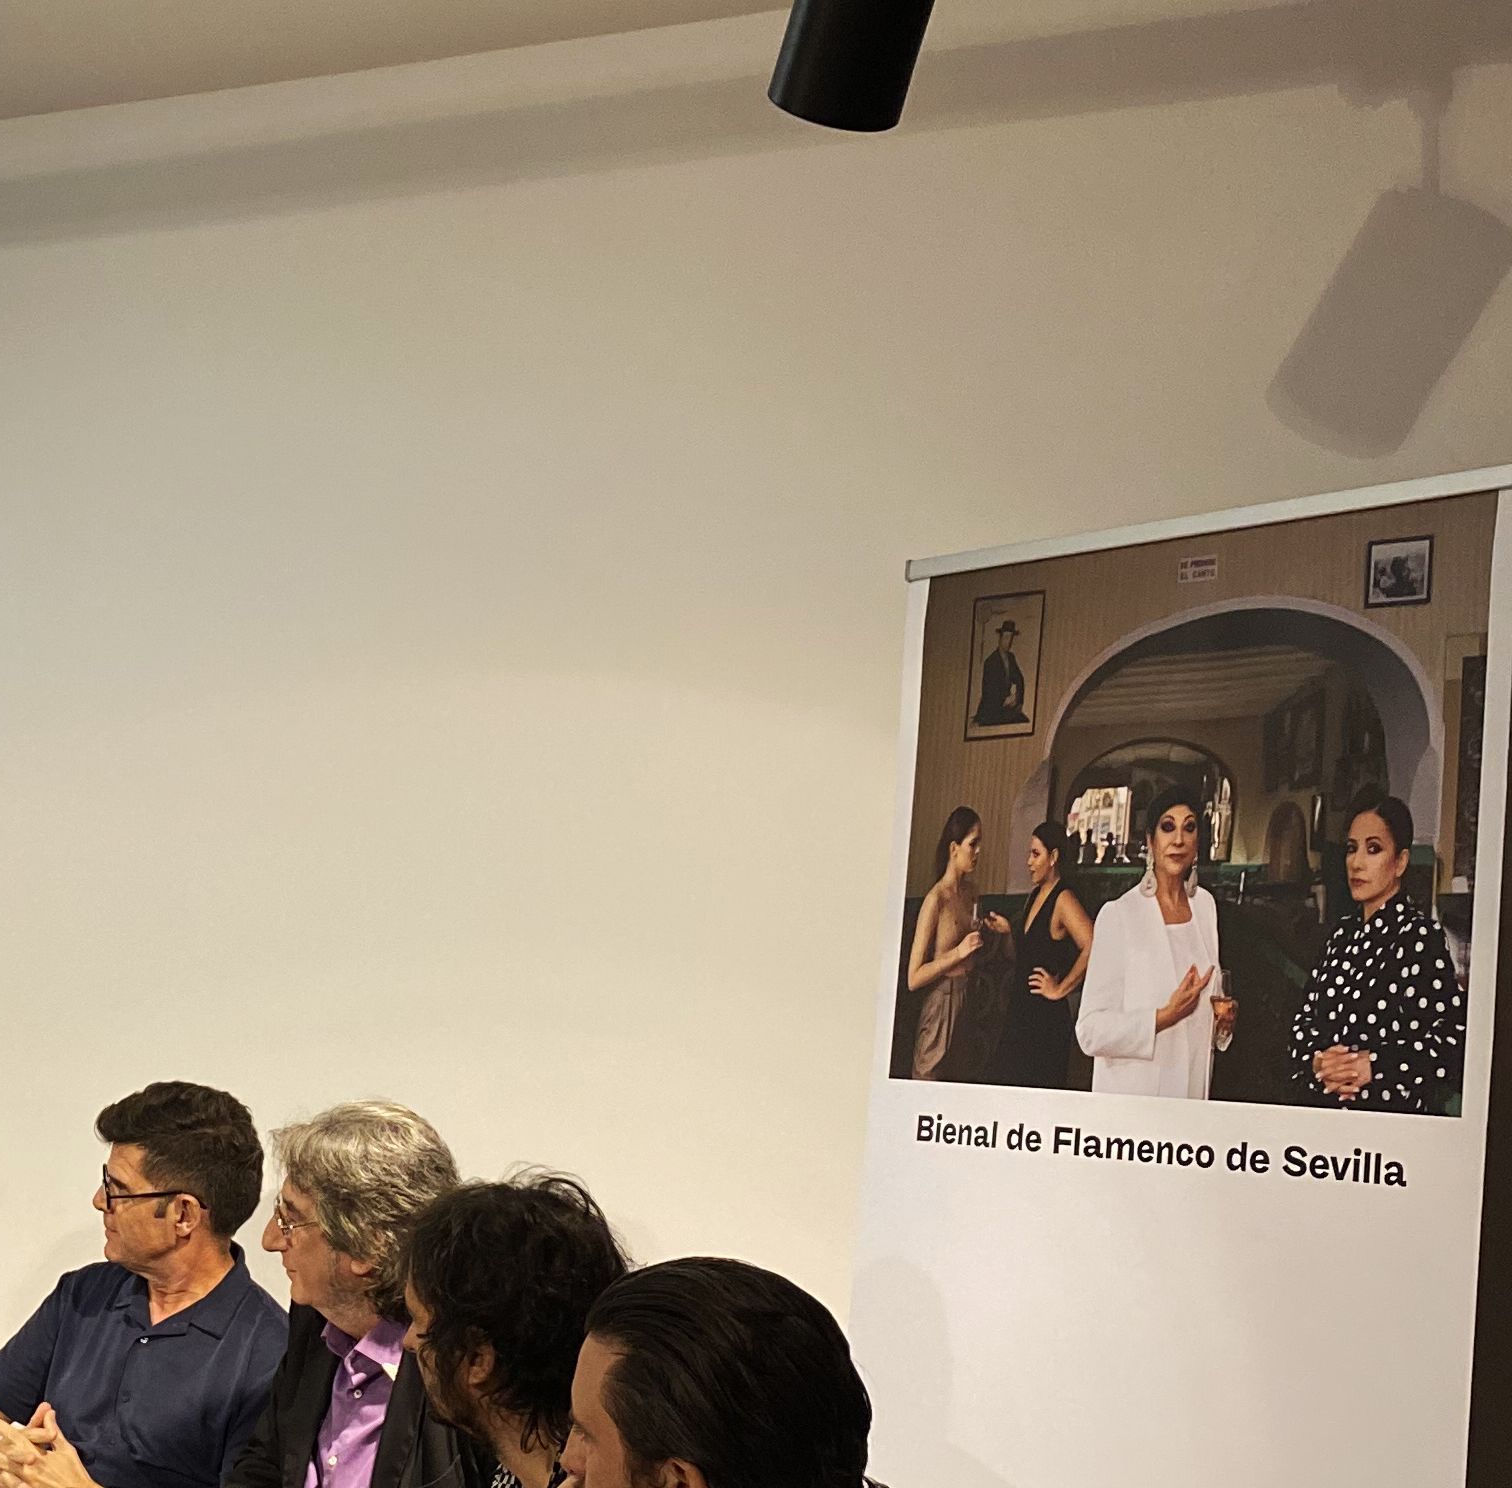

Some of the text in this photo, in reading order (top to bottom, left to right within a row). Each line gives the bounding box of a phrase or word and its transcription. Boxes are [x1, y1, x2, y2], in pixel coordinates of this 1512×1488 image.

[916, 1114, 1407, 1188] Bienal de Flamenco de Sevilla
